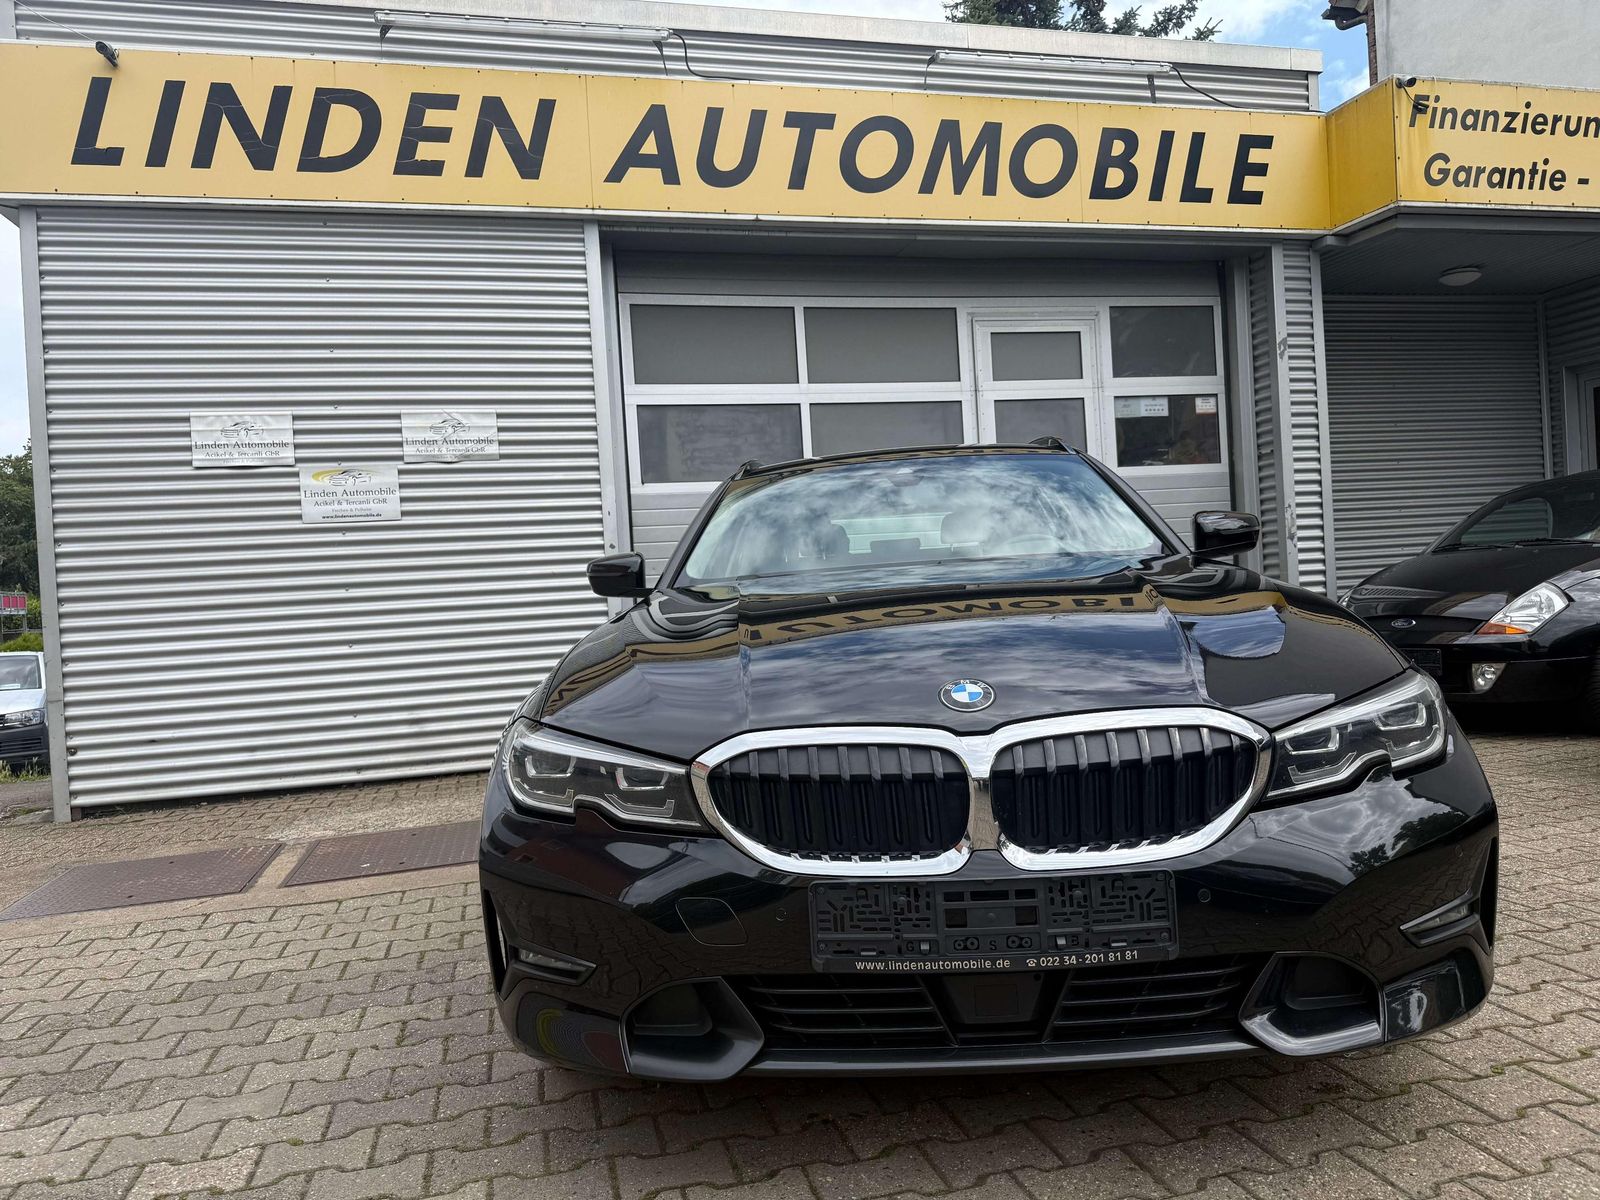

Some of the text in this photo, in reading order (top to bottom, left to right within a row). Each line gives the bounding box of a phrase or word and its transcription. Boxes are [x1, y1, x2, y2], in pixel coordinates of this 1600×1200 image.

[1409, 94, 1600, 138] Finanzierun
[71, 76, 1274, 205] LINDEN AUTOMOBILE
[1424, 152, 1567, 191] Garantie
[194, 439, 290, 449] Linden Automobile
[406, 436, 494, 446] Linden Automobile
[304, 487, 397, 498] Linden Automobile
[346, 498, 371, 506] Tercanli
[855, 959, 1011, 970] www.lindenautomobile.de
[1040, 957, 1060, 966] 022
[1108, 952, 1121, 962] 81
[1125, 950, 1138, 960] 81
